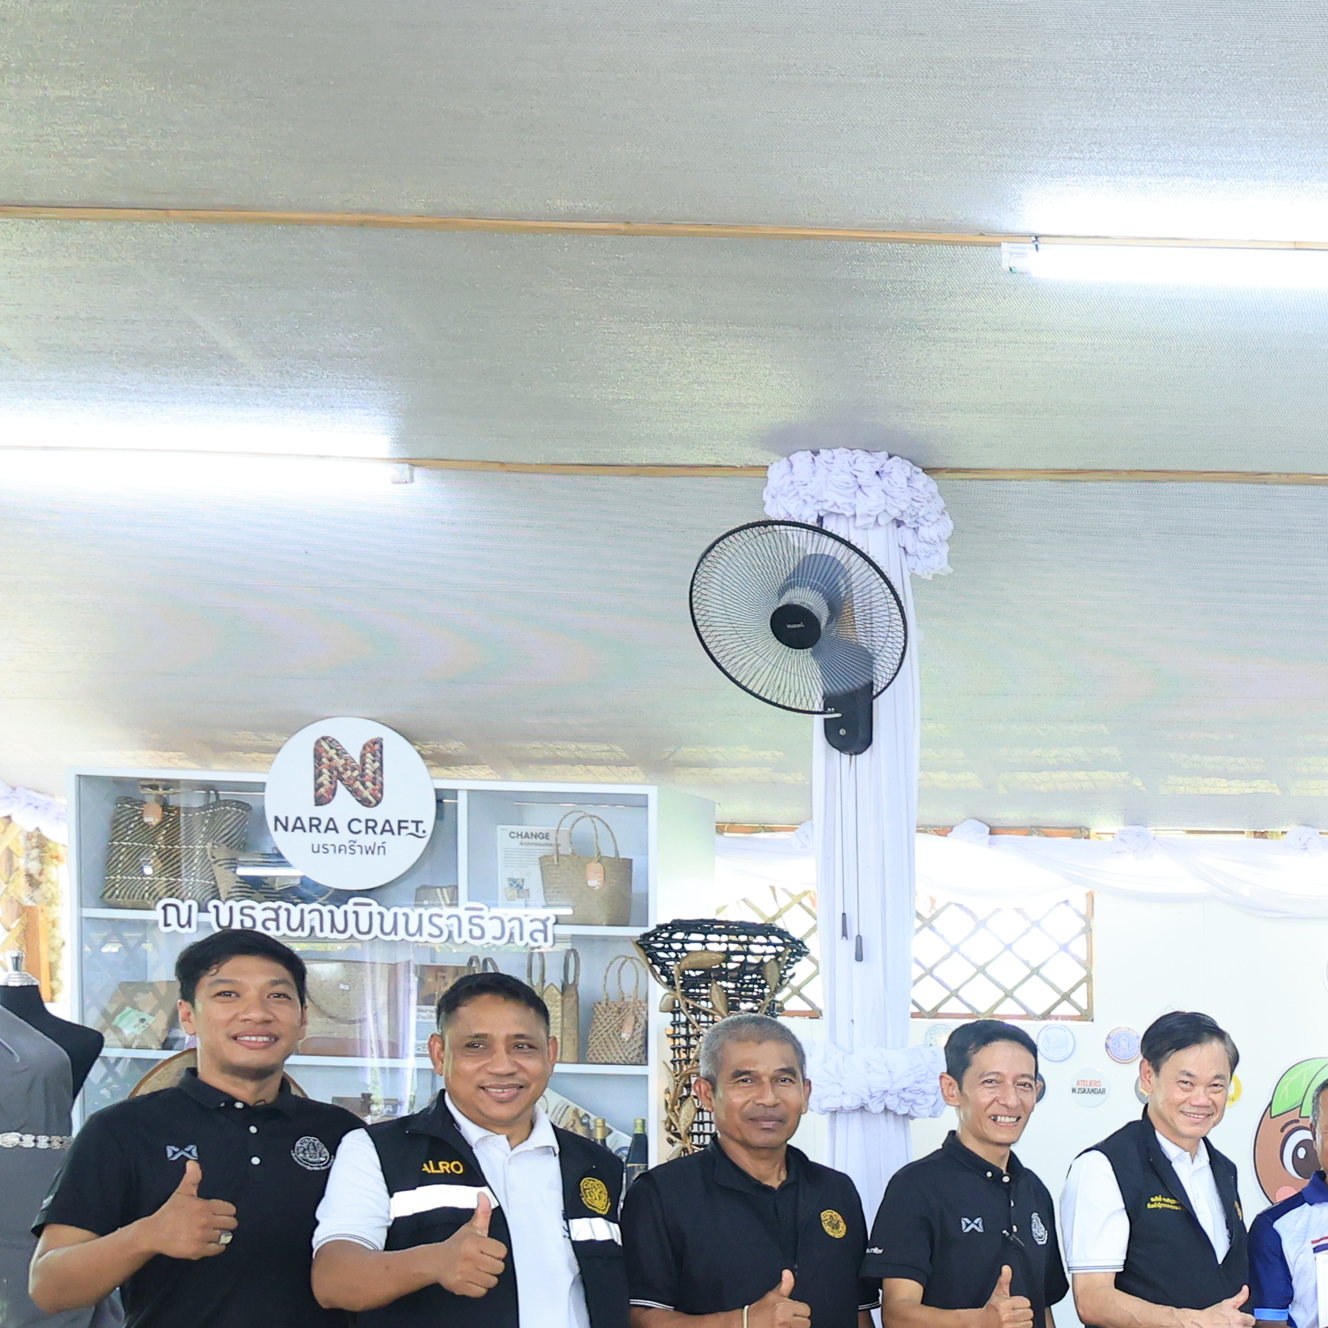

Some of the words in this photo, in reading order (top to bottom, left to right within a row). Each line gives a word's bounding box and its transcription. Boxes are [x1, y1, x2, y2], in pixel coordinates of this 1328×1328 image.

[273, 815, 340, 834] NARA
[509, 831, 551, 841] CHANGE
[161, 903, 192, 929] ณ
[213, 902, 551, 943] บธสนามบินนราธิวาส
[1076, 1079, 1102, 1087] ATELIERS
